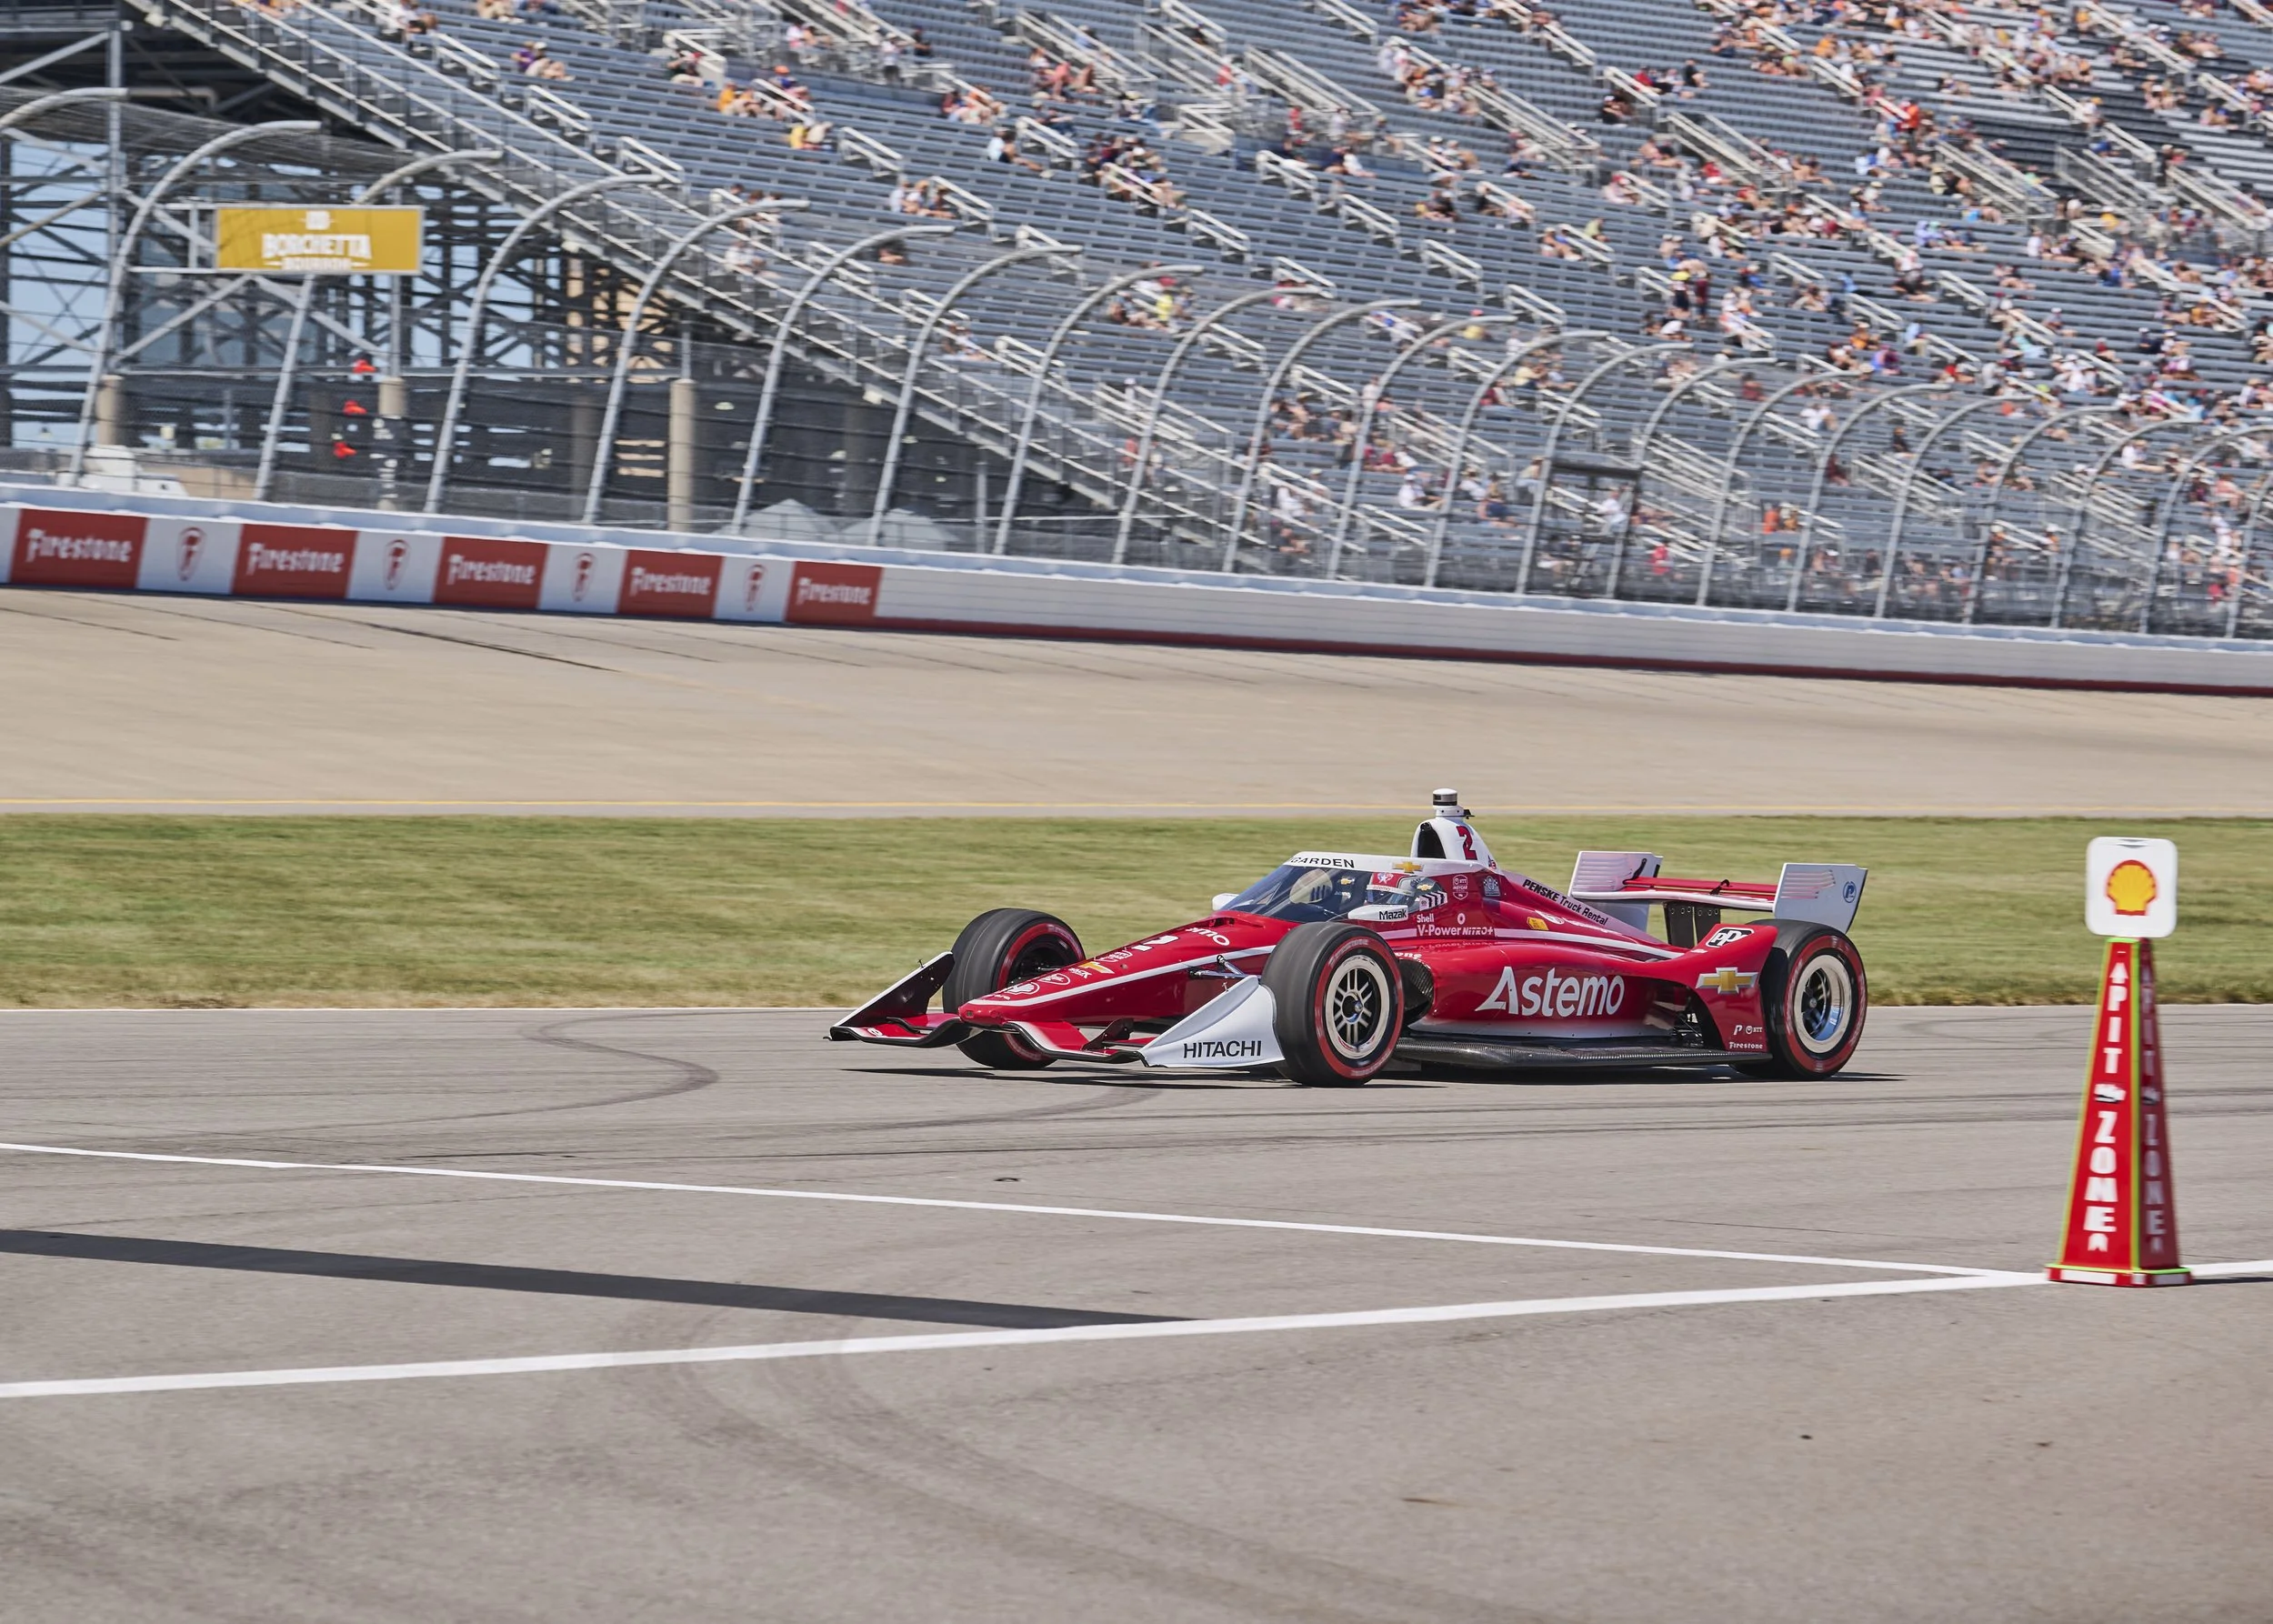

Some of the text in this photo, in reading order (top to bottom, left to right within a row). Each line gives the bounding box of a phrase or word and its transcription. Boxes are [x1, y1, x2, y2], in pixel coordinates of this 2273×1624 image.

[25, 529, 133, 563] Firestone
[246, 542, 345, 576] Firestone
[448, 555, 536, 586] Firestone
[631, 566, 712, 596] Firestone
[796, 577, 870, 606] Firestone
[1456, 826, 1477, 860] 2
[1378, 909, 1407, 920] Mazak
[1522, 879, 1609, 926] PENSKE Truck Rental
[1417, 913, 1434, 923] Shell
[1417, 924, 1461, 936] V-Power
[1475, 966, 1625, 1018] Astemo
[1184, 1040, 1261, 1058] HITACHI
[1729, 1041, 1763, 1049] Firestone
[2084, 985, 2128, 1232] PIT ZONE
